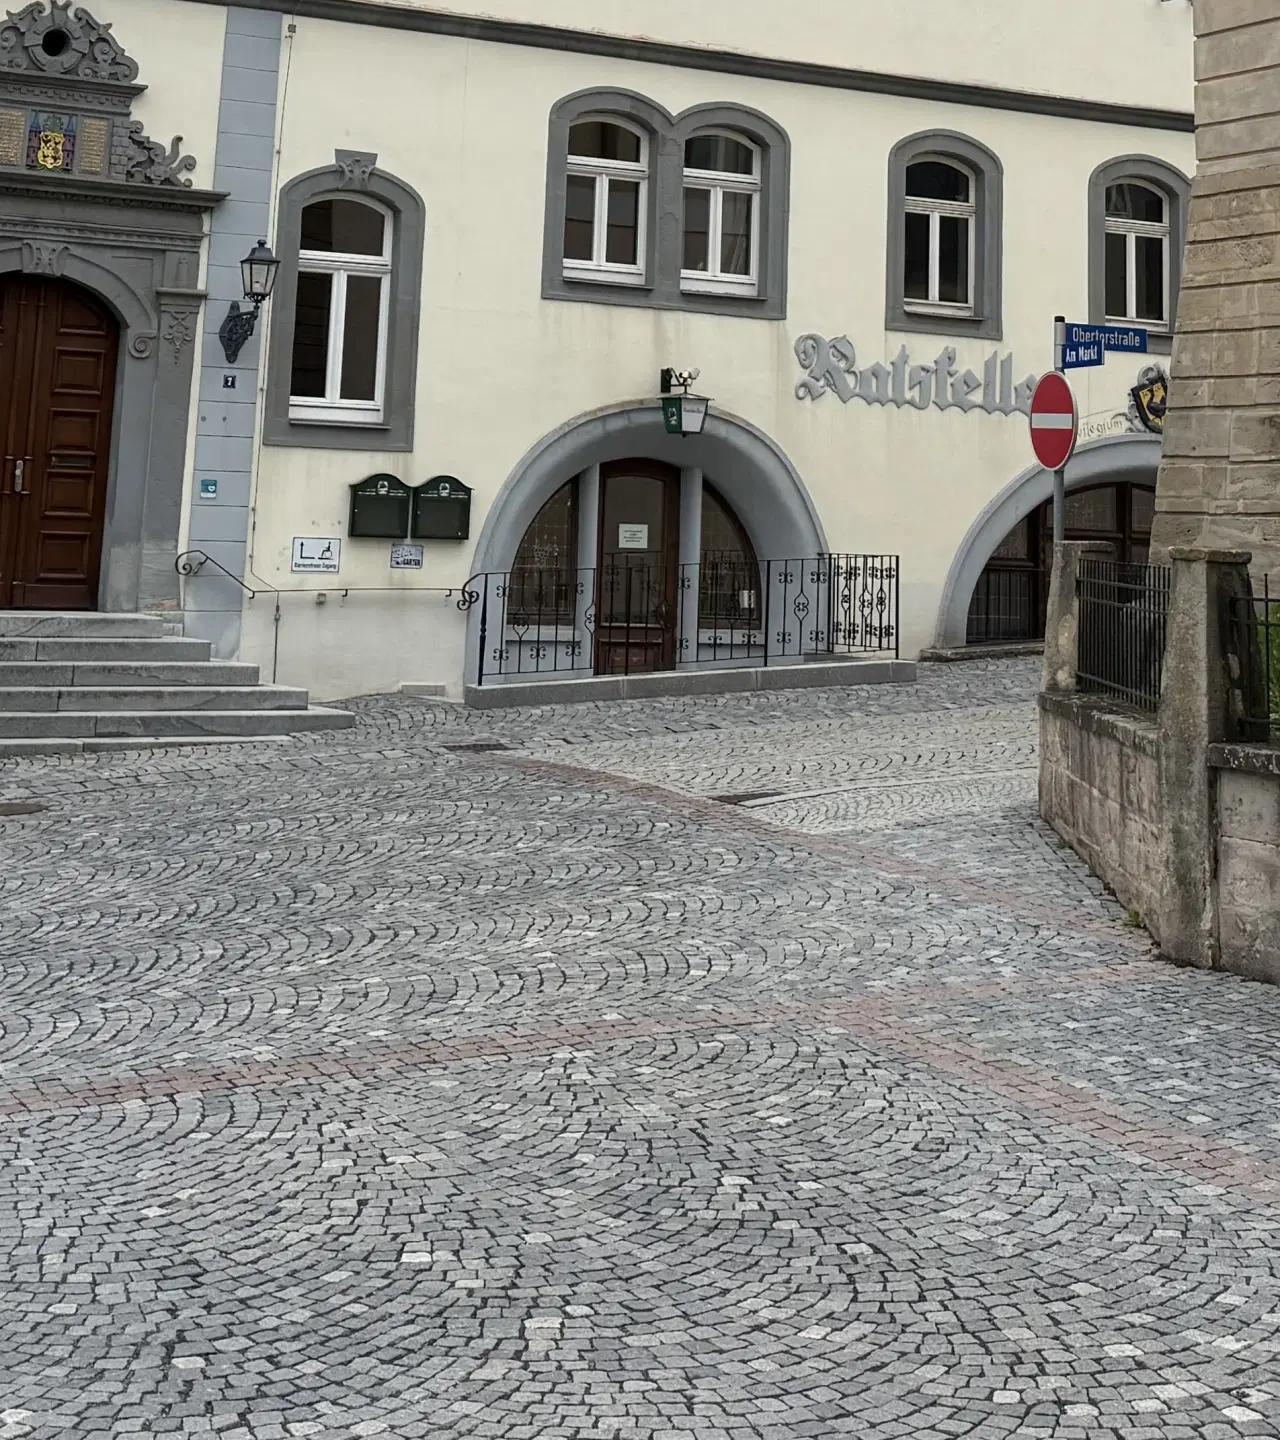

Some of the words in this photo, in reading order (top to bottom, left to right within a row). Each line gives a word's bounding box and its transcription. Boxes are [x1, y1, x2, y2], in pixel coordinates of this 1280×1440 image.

[1072, 327, 1141, 347] Obertorstraße
[1065, 348, 1077, 363] Am
[1078, 345, 1098, 362] Markt
[794, 333, 1033, 418] Ratskelle
